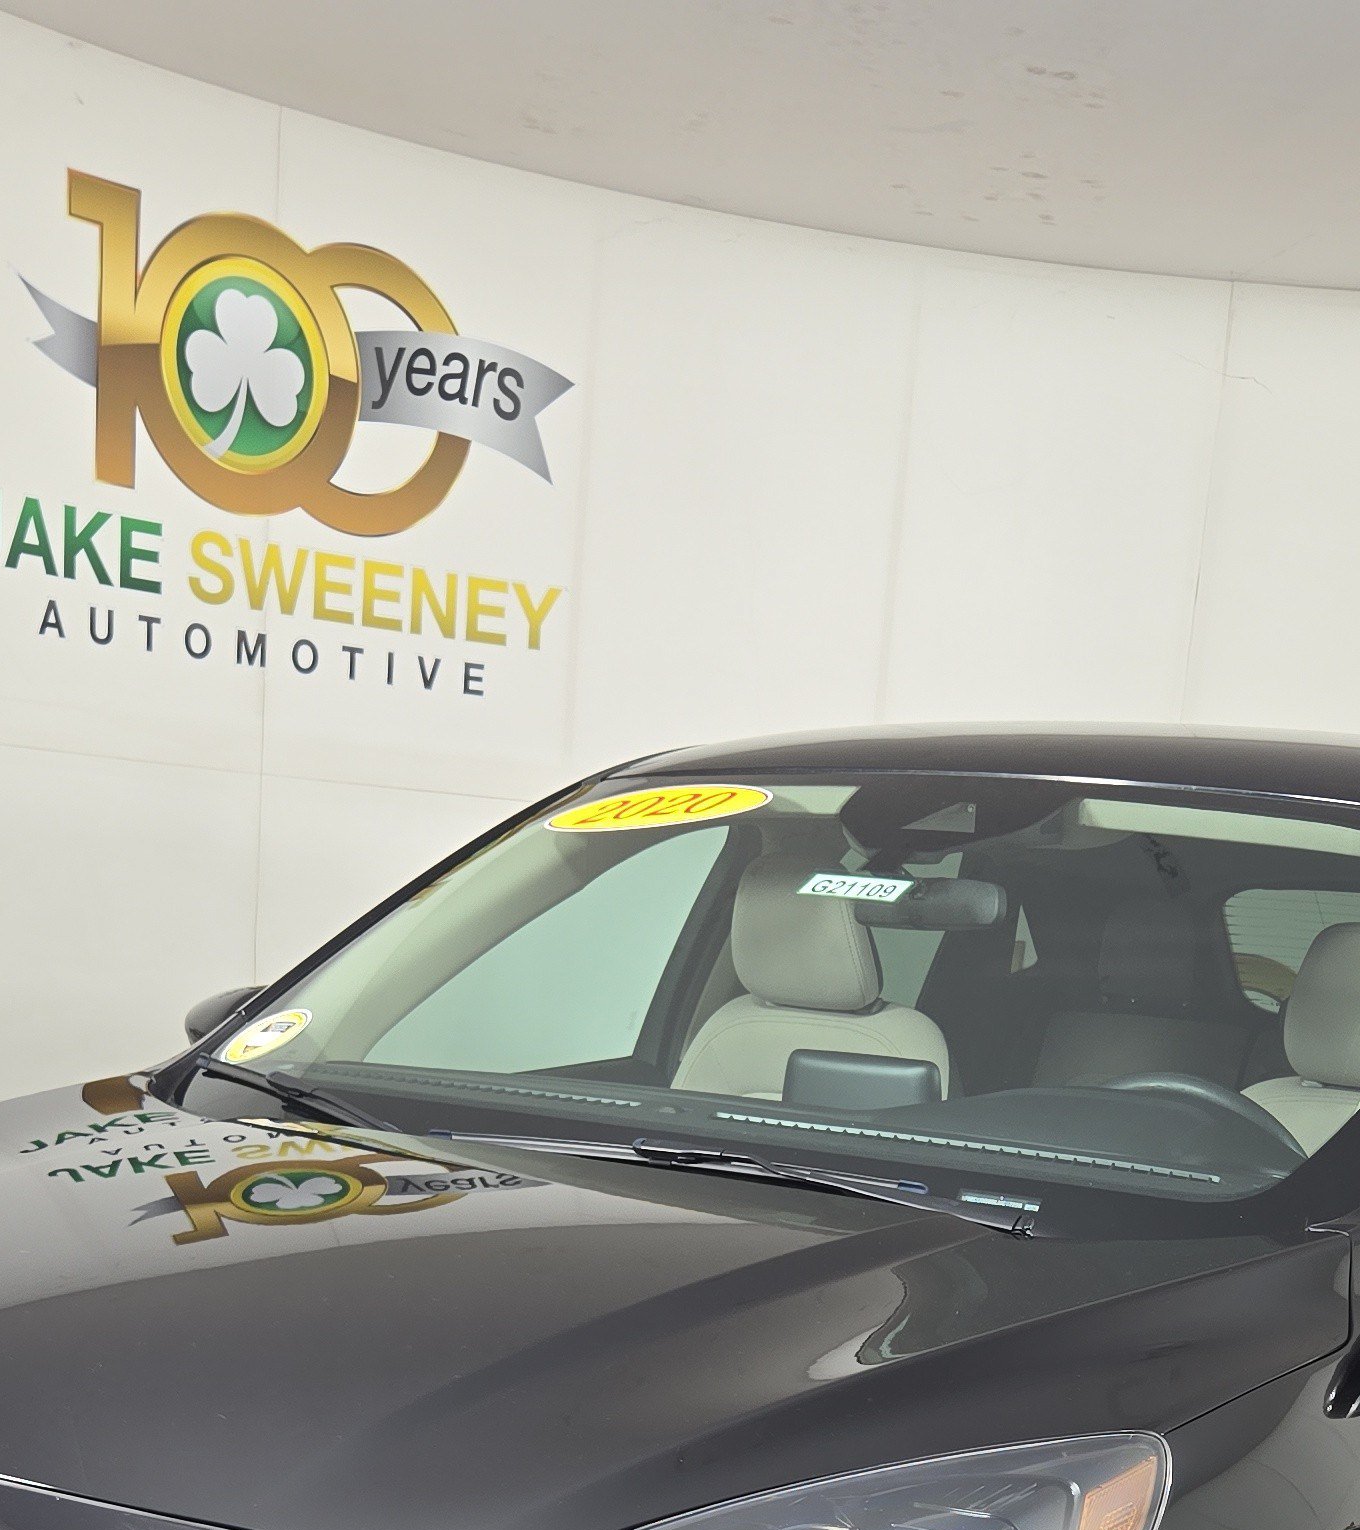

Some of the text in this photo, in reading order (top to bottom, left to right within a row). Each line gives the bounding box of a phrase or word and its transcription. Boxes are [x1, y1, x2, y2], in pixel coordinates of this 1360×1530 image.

[370, 345, 526, 422] years
[187, 530, 562, 651] SWEENEY
[38, 599, 486, 698] AUTOMOTIVE
[574, 791, 738, 825] 2020
[811, 878, 898, 899] G21109
